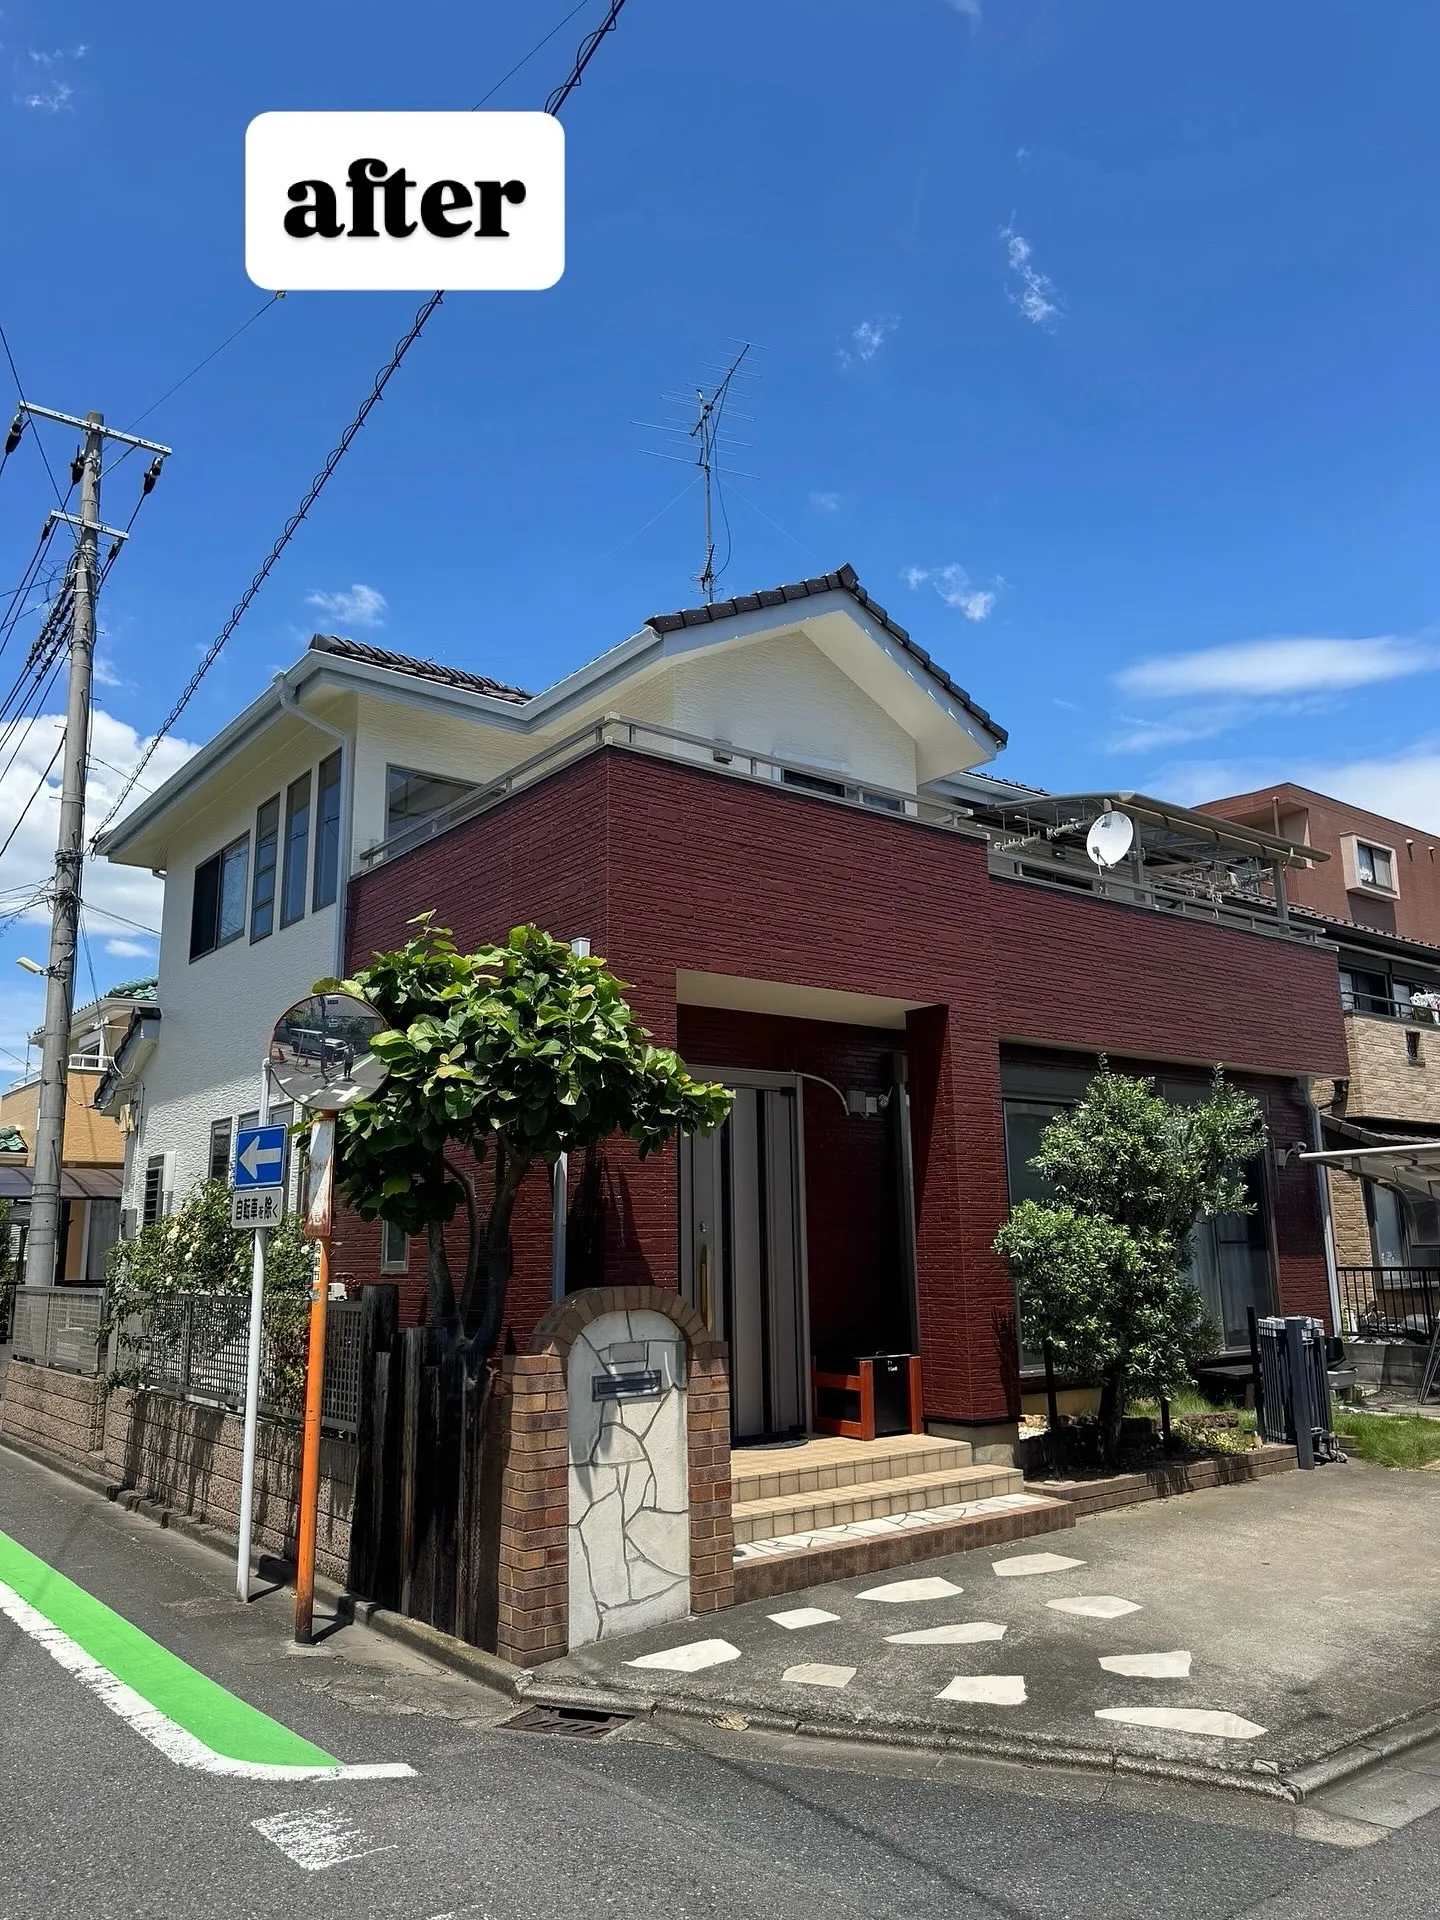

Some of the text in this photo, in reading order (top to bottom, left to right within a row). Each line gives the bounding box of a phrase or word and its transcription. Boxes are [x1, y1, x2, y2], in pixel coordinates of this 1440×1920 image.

[236, 1195, 278, 1220] 自転車を除く
